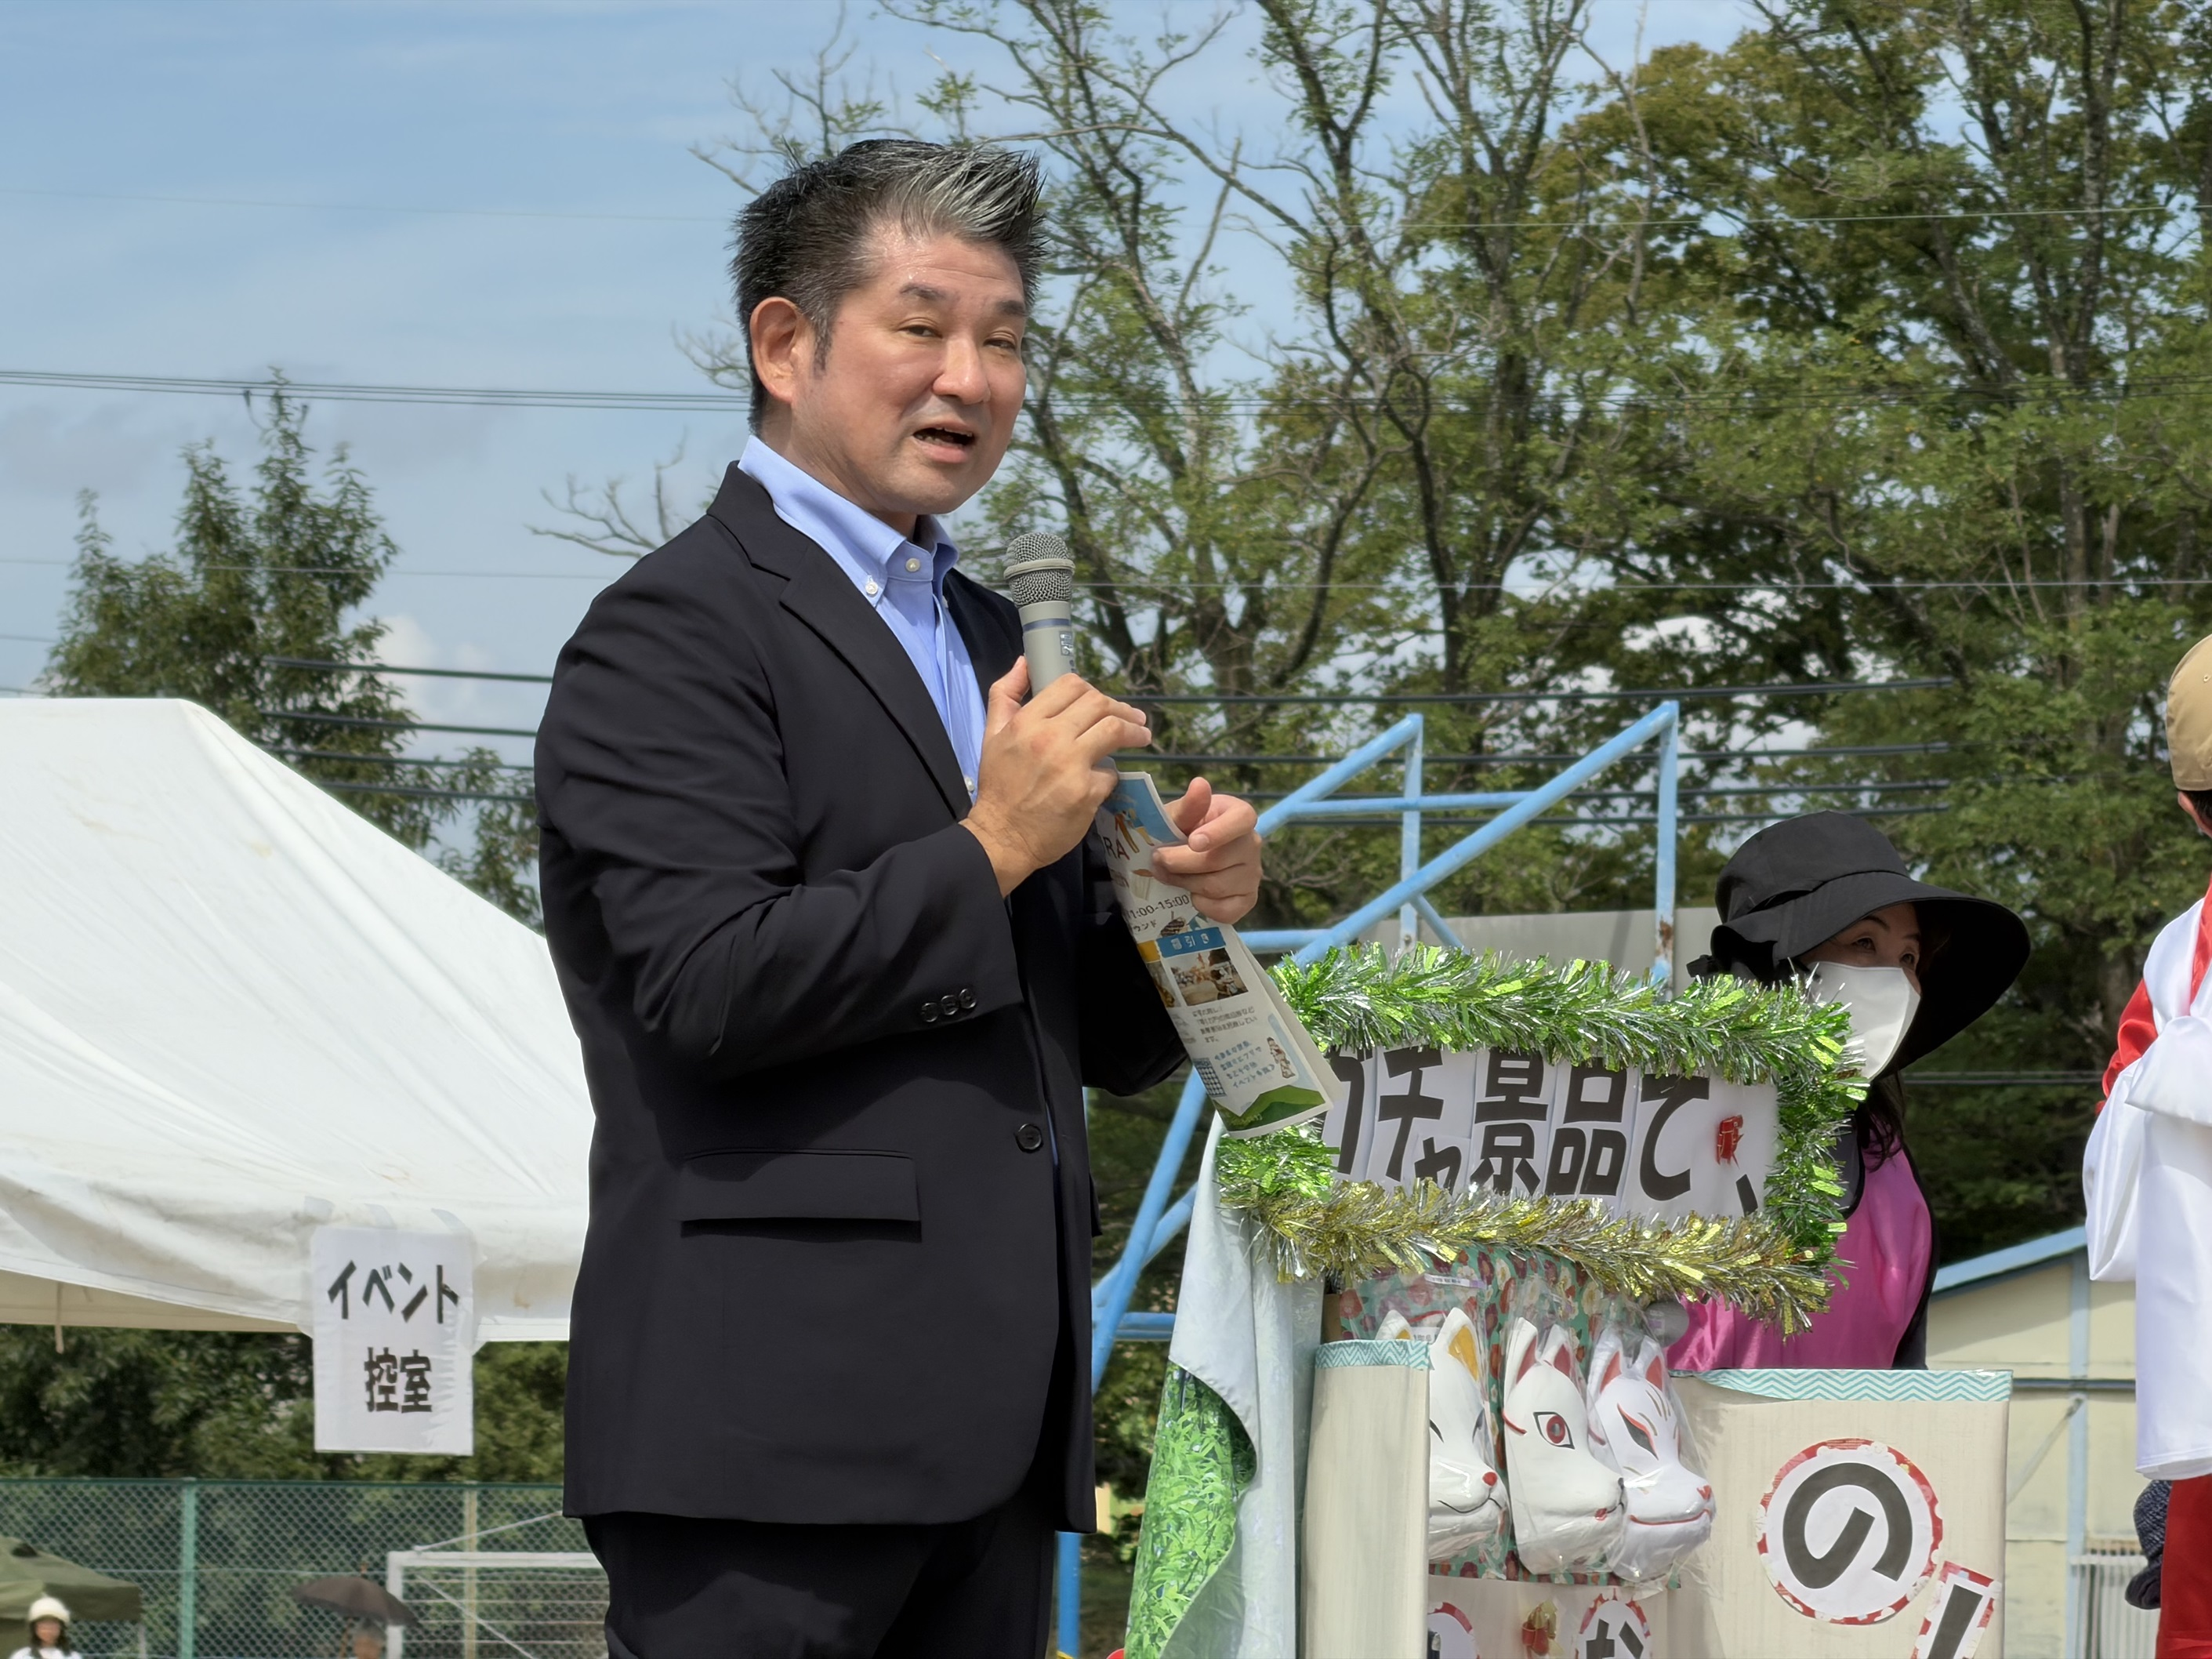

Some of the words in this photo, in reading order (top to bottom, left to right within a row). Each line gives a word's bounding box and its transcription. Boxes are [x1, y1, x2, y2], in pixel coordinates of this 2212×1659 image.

[328, 1260, 459, 1324] イベント
[364, 1347, 433, 1414] 控室
[1782, 1462, 1913, 1589] の
